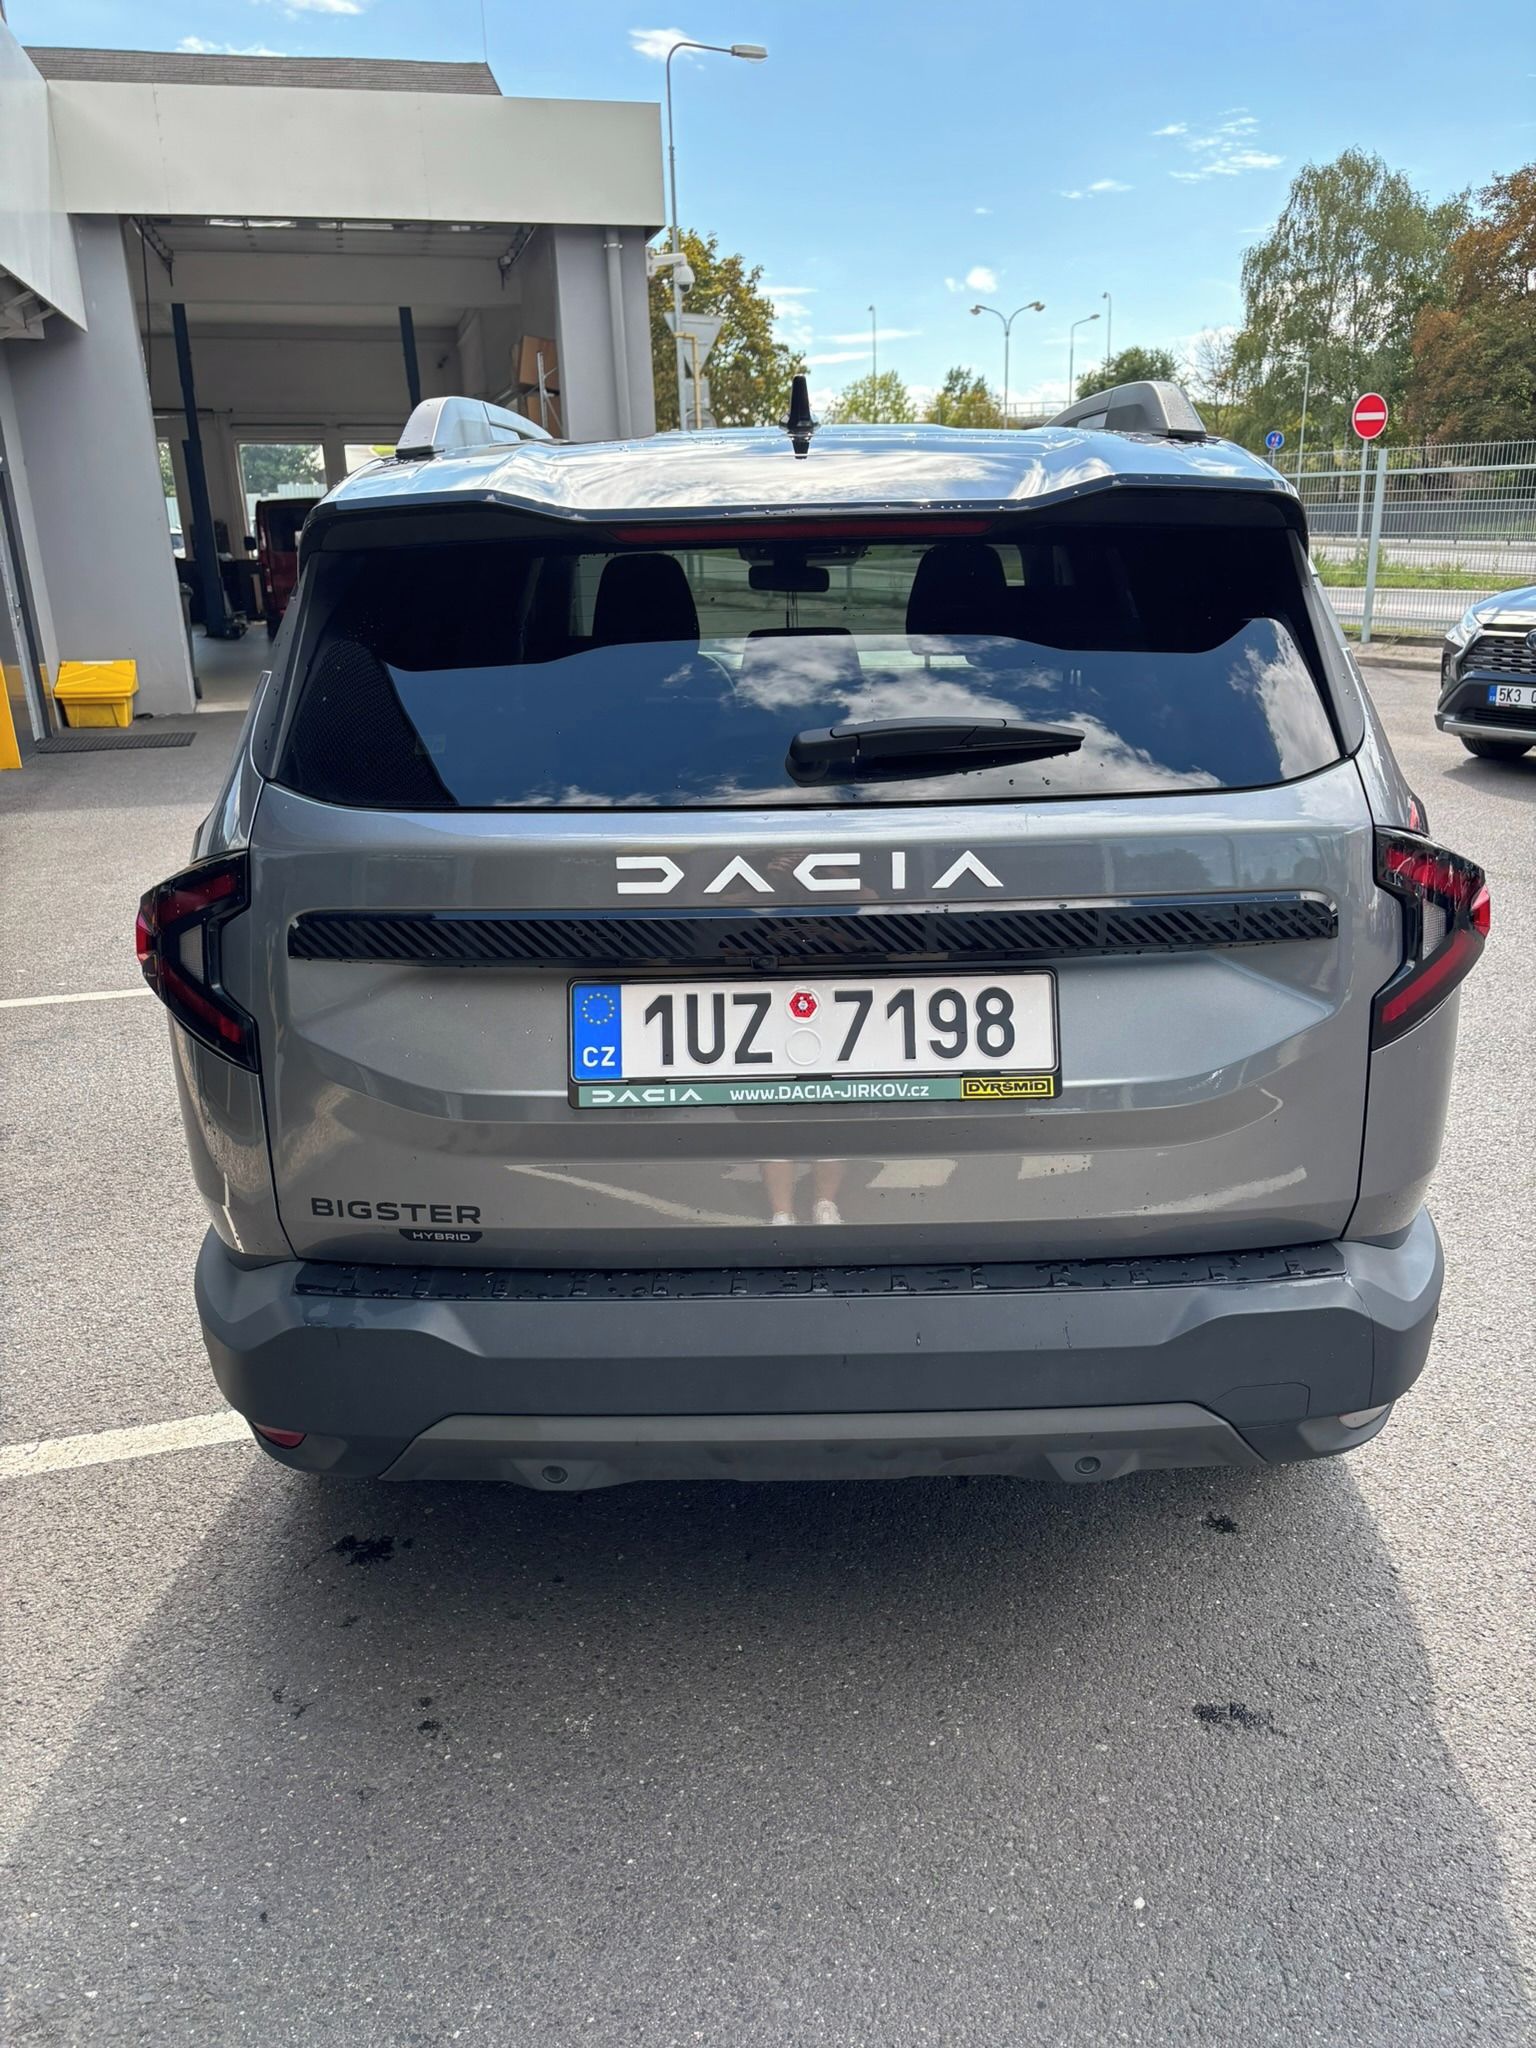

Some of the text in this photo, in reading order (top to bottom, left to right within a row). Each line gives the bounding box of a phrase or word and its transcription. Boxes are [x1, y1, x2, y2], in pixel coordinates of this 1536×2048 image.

[1499, 687, 1521, 703] 5K3
[615, 850, 1004, 894] DACIA
[645, 987, 1016, 1066] 1UZ 7198
[582, 1046, 616, 1067] CZ
[592, 1088, 703, 1103] DACIA
[730, 1083, 929, 1101] www.DACIA-JIRKOV.cz
[311, 1197, 481, 1224] BIGSTER
[412, 1231, 471, 1241] HYBRID
